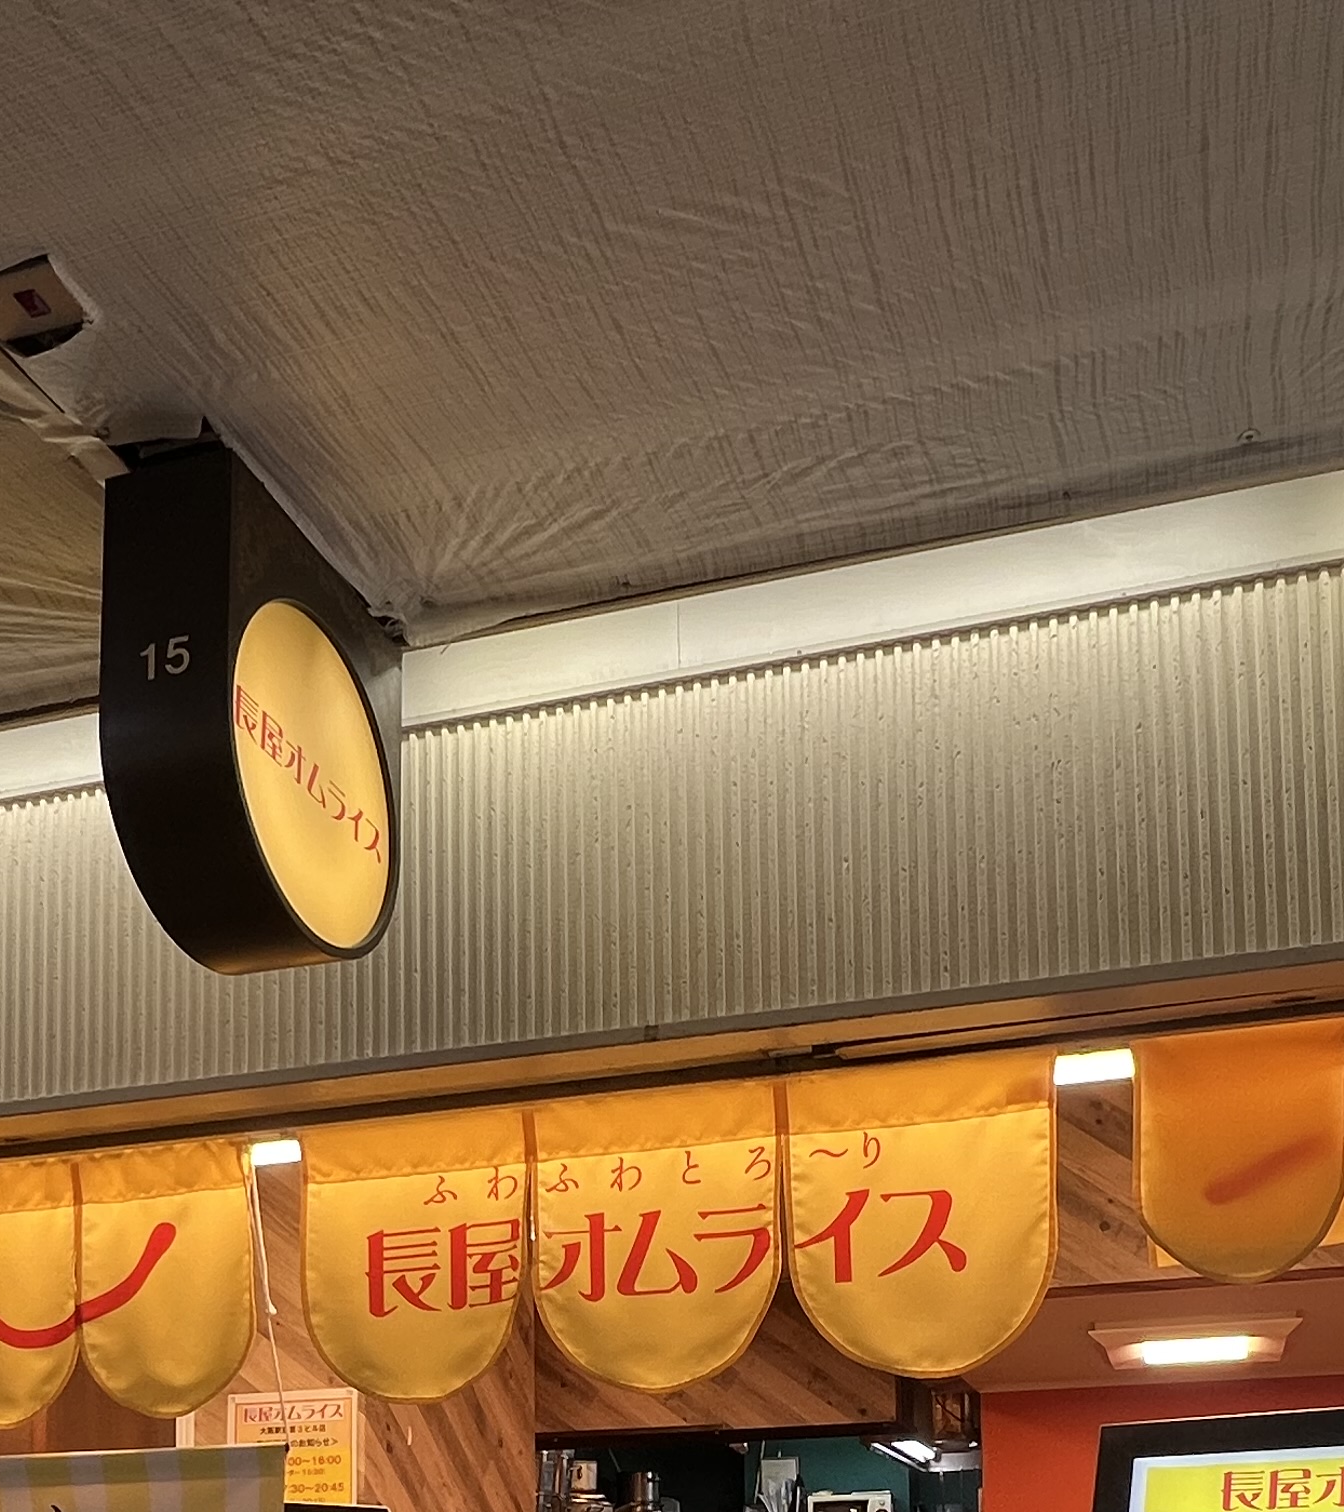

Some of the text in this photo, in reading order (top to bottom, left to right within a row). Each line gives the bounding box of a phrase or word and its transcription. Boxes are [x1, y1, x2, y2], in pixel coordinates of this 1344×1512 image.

[139, 634, 191, 681] 15
[234, 684, 382, 864] 長屋オムライス
[364, 1188, 967, 1319] 長屋オムライス
[243, 1403, 344, 1423] 長屋オムライス
